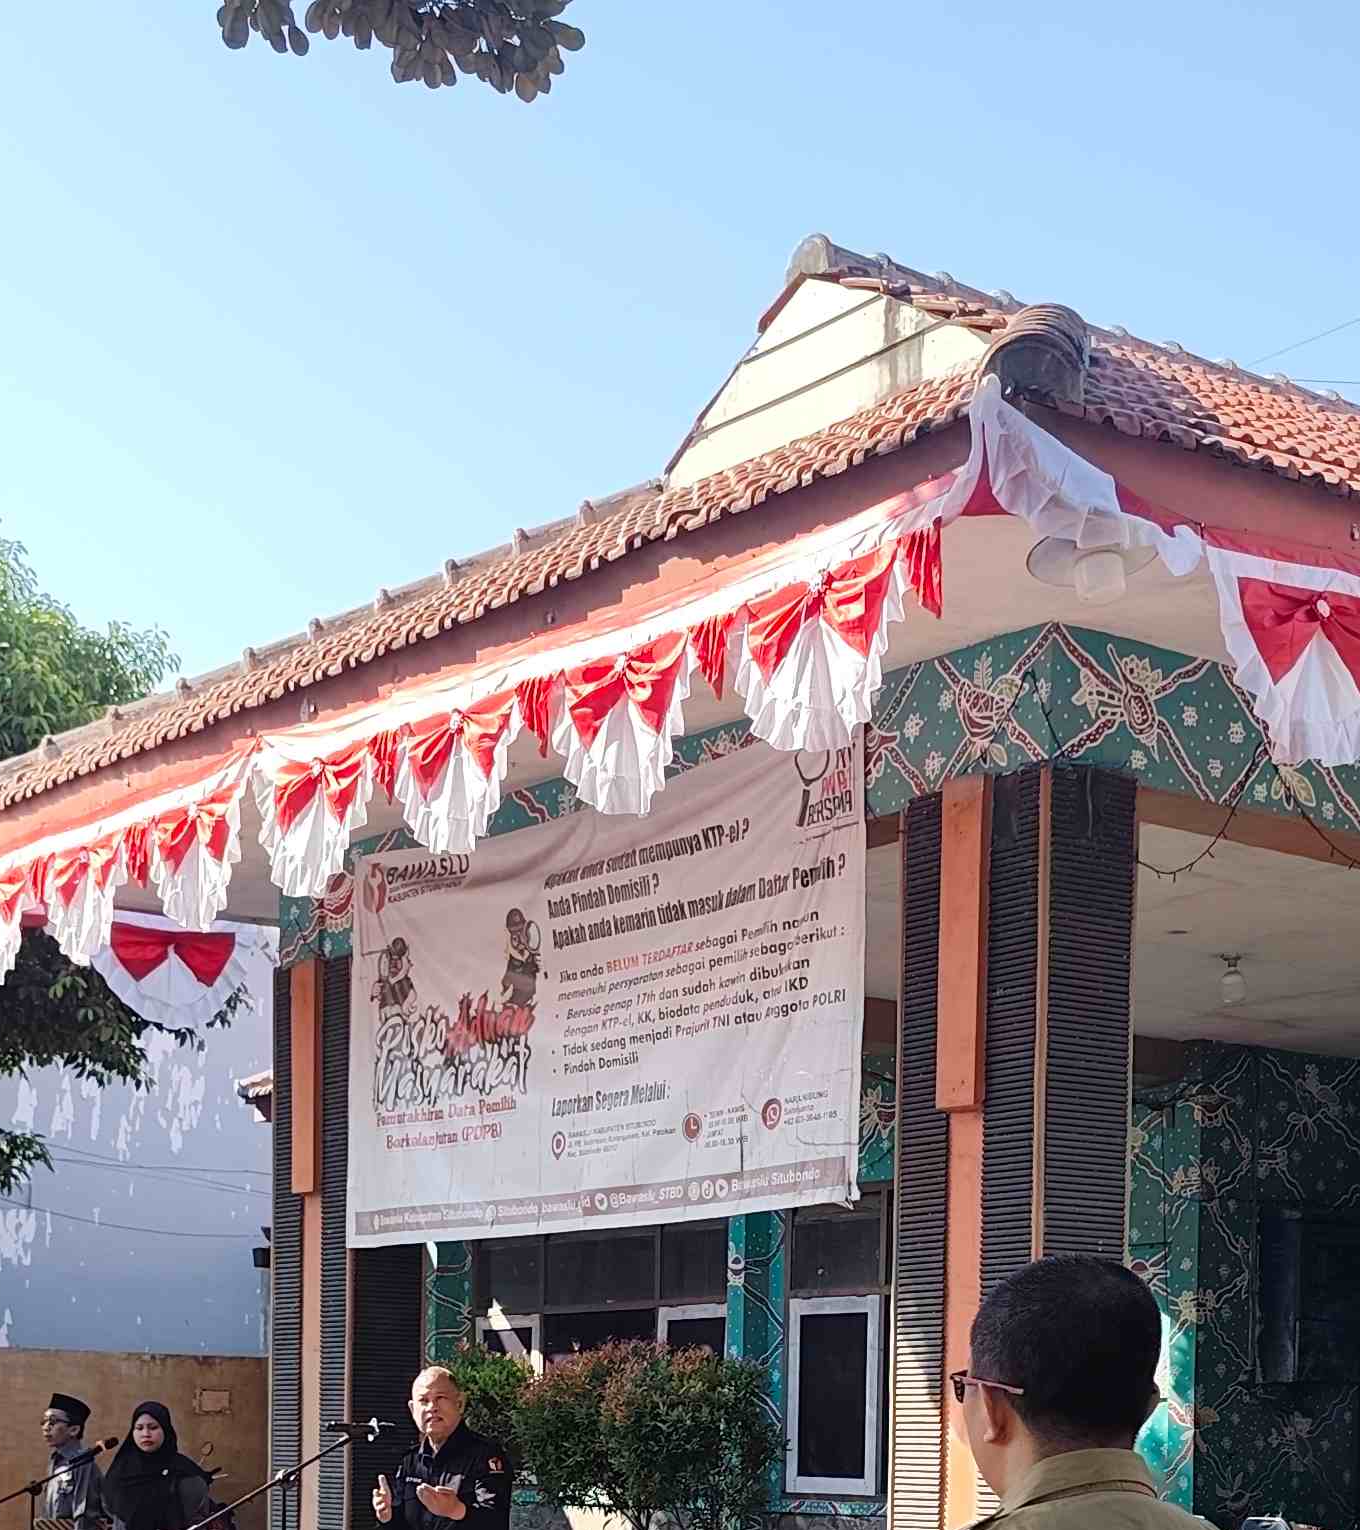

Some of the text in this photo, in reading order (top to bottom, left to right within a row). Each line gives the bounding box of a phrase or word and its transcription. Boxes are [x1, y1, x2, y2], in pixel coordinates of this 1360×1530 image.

[639, 834, 702, 865] mempunya
[702, 820, 740, 850] KTP-el
[741, 818, 750, 840] ?
[386, 854, 470, 885] BAWASLU
[547, 872, 660, 919] Anda Pindah Domisili ?
[552, 919, 587, 950] Apakah
[587, 916, 612, 941] anda
[613, 907, 657, 935] kemarin
[657, 900, 687, 925] tidak
[688, 888, 725, 918] masuk
[725, 883, 756, 909] dalam
[838, 853, 846, 876] ?
[558, 982, 607, 1002] memenuhi
[608, 970, 663, 995] persyaratan
[666, 957, 706, 978] sebagai
[749, 940, 795, 959] sebaga
[559, 970, 578, 984] Jika
[606, 954, 640, 973] BELUM
[642, 941, 694, 966] TERDAFTAR
[695, 930, 738, 951] sebagai
[637, 1010, 656, 1027] KK,
[658, 1003, 700, 1021] biodata
[784, 976, 809, 994] IKD
[659, 987, 679, 1001] dan
[682, 978, 715, 997] sudah
[376, 1007, 448, 1062] Posko
[562, 1042, 588, 1058] Tidak
[590, 1034, 626, 1052] sedang
[629, 1026, 672, 1046] menjadi
[712, 1014, 730, 1028] TNI
[734, 1010, 762, 1026] atau
[812, 988, 846, 1008] POLRI
[375, 1034, 532, 1112] Masyarakat
[564, 1051, 639, 1076] Pindah Domisili
[551, 1094, 594, 1118] Laporkan
[595, 1089, 630, 1112] Segera
[631, 1080, 667, 1106] Melalui
